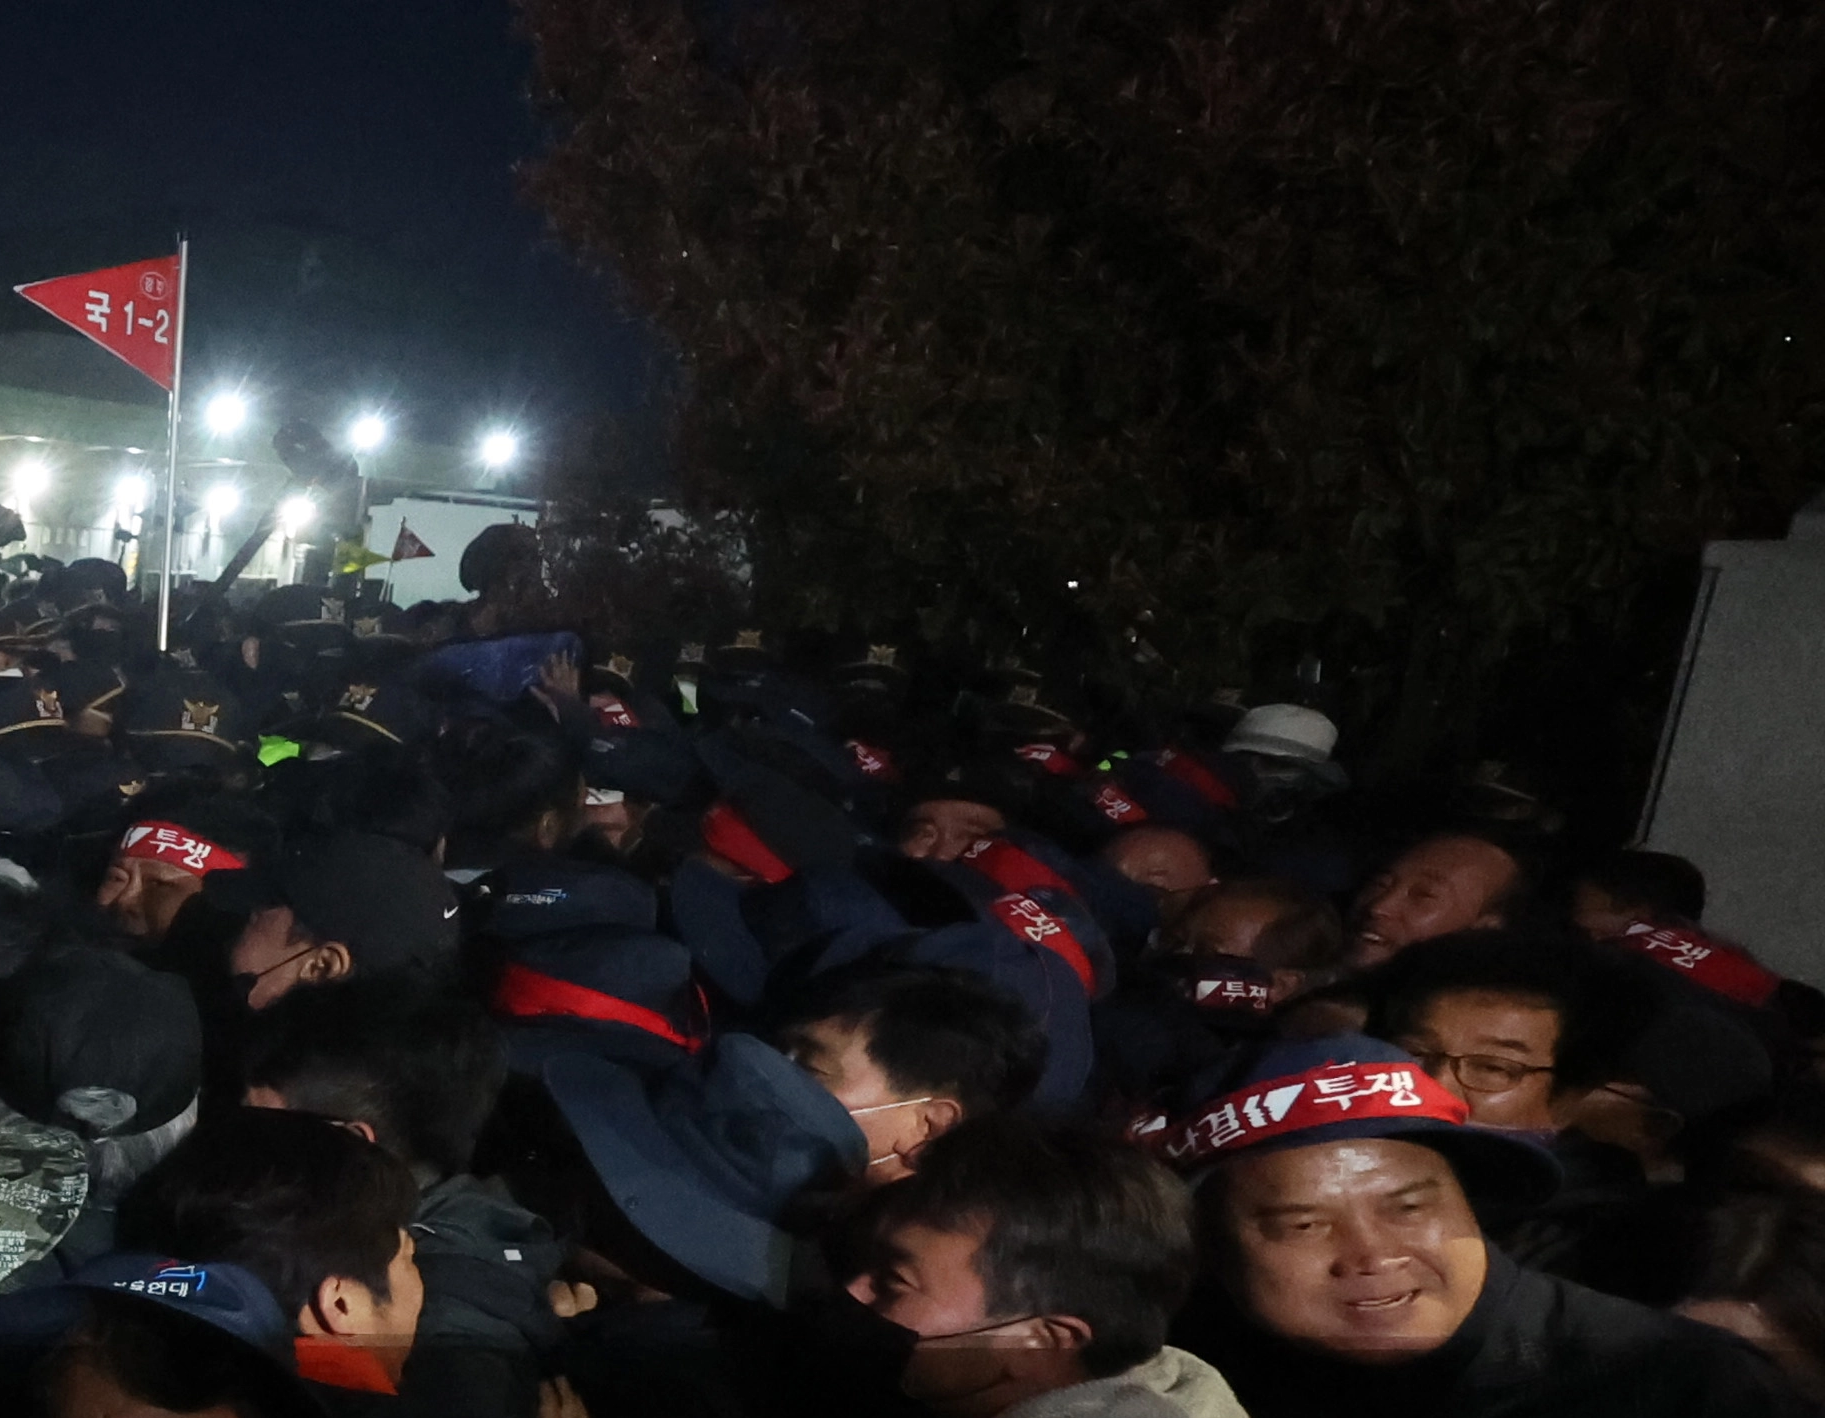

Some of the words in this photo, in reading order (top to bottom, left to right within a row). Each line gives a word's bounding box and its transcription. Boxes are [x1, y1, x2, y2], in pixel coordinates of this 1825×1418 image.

[85, 290, 111, 333] 국
[124, 301, 170, 345] 1-2
[149, 828, 213, 870] 투쟁
[1011, 897, 1062, 942] 투쟁
[1644, 930, 1713, 970] 투쟁
[1222, 980, 1268, 1009] 투쟁
[1313, 1068, 1423, 1112] 투쟁
